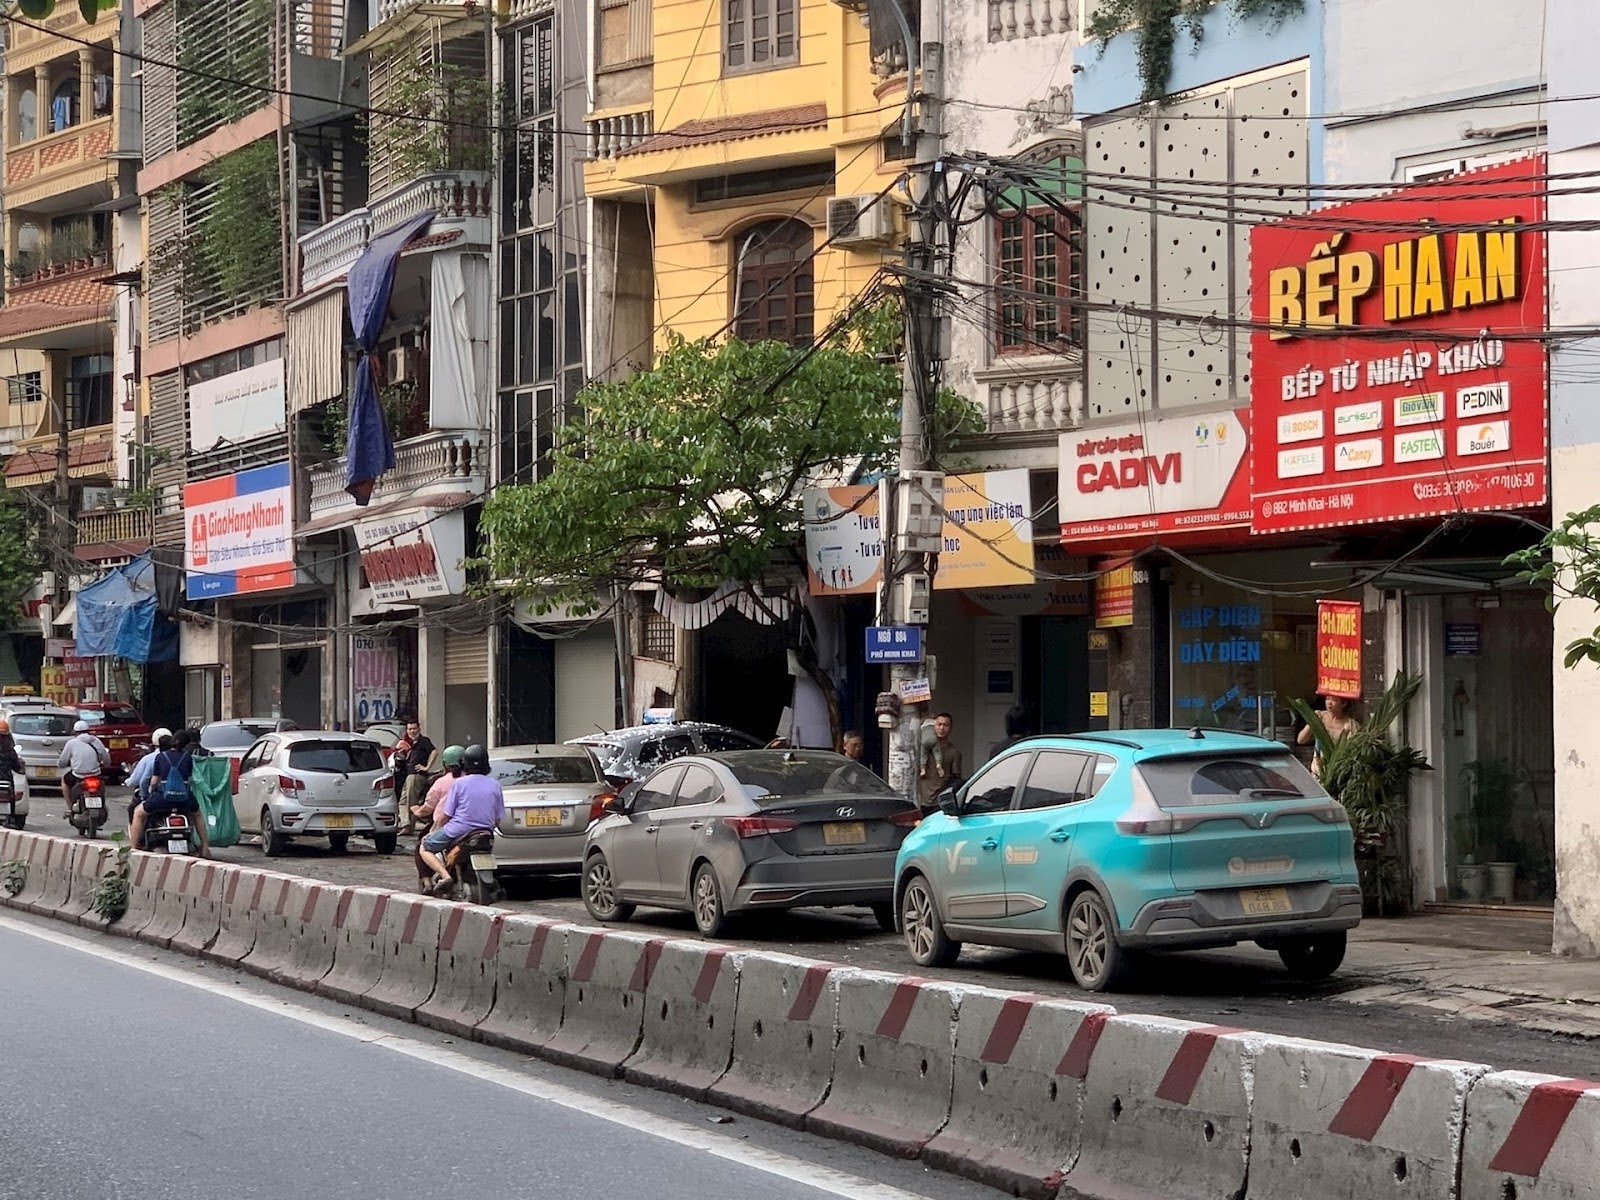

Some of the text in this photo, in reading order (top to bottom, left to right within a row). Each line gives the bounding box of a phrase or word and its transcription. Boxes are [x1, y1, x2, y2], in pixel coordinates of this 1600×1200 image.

[1269, 216, 1518, 341] BẾP HÀ AN
[1281, 363, 1324, 401] BẾP
[1329, 359, 1361, 393] TỪ
[1366, 348, 1432, 387] NHẬP
[1463, 388, 1503, 411] PEDINI
[1292, 419, 1319, 434] BOSCH
[1401, 439, 1437, 455] FASTER
[1470, 440, 1496, 451] Bauer
[1077, 452, 1182, 493] CADIVI
[985, 502, 1004, 523] việc
[1289, 497, 1307, 513] Minh
[1308, 495, 1325, 511] Khai
[208, 499, 284, 538] GiaoHangNhanh
[944, 536, 960, 555] học
[1133, 570, 1149, 584] 884
[1219, 637, 1261, 664] ĐIỆN
